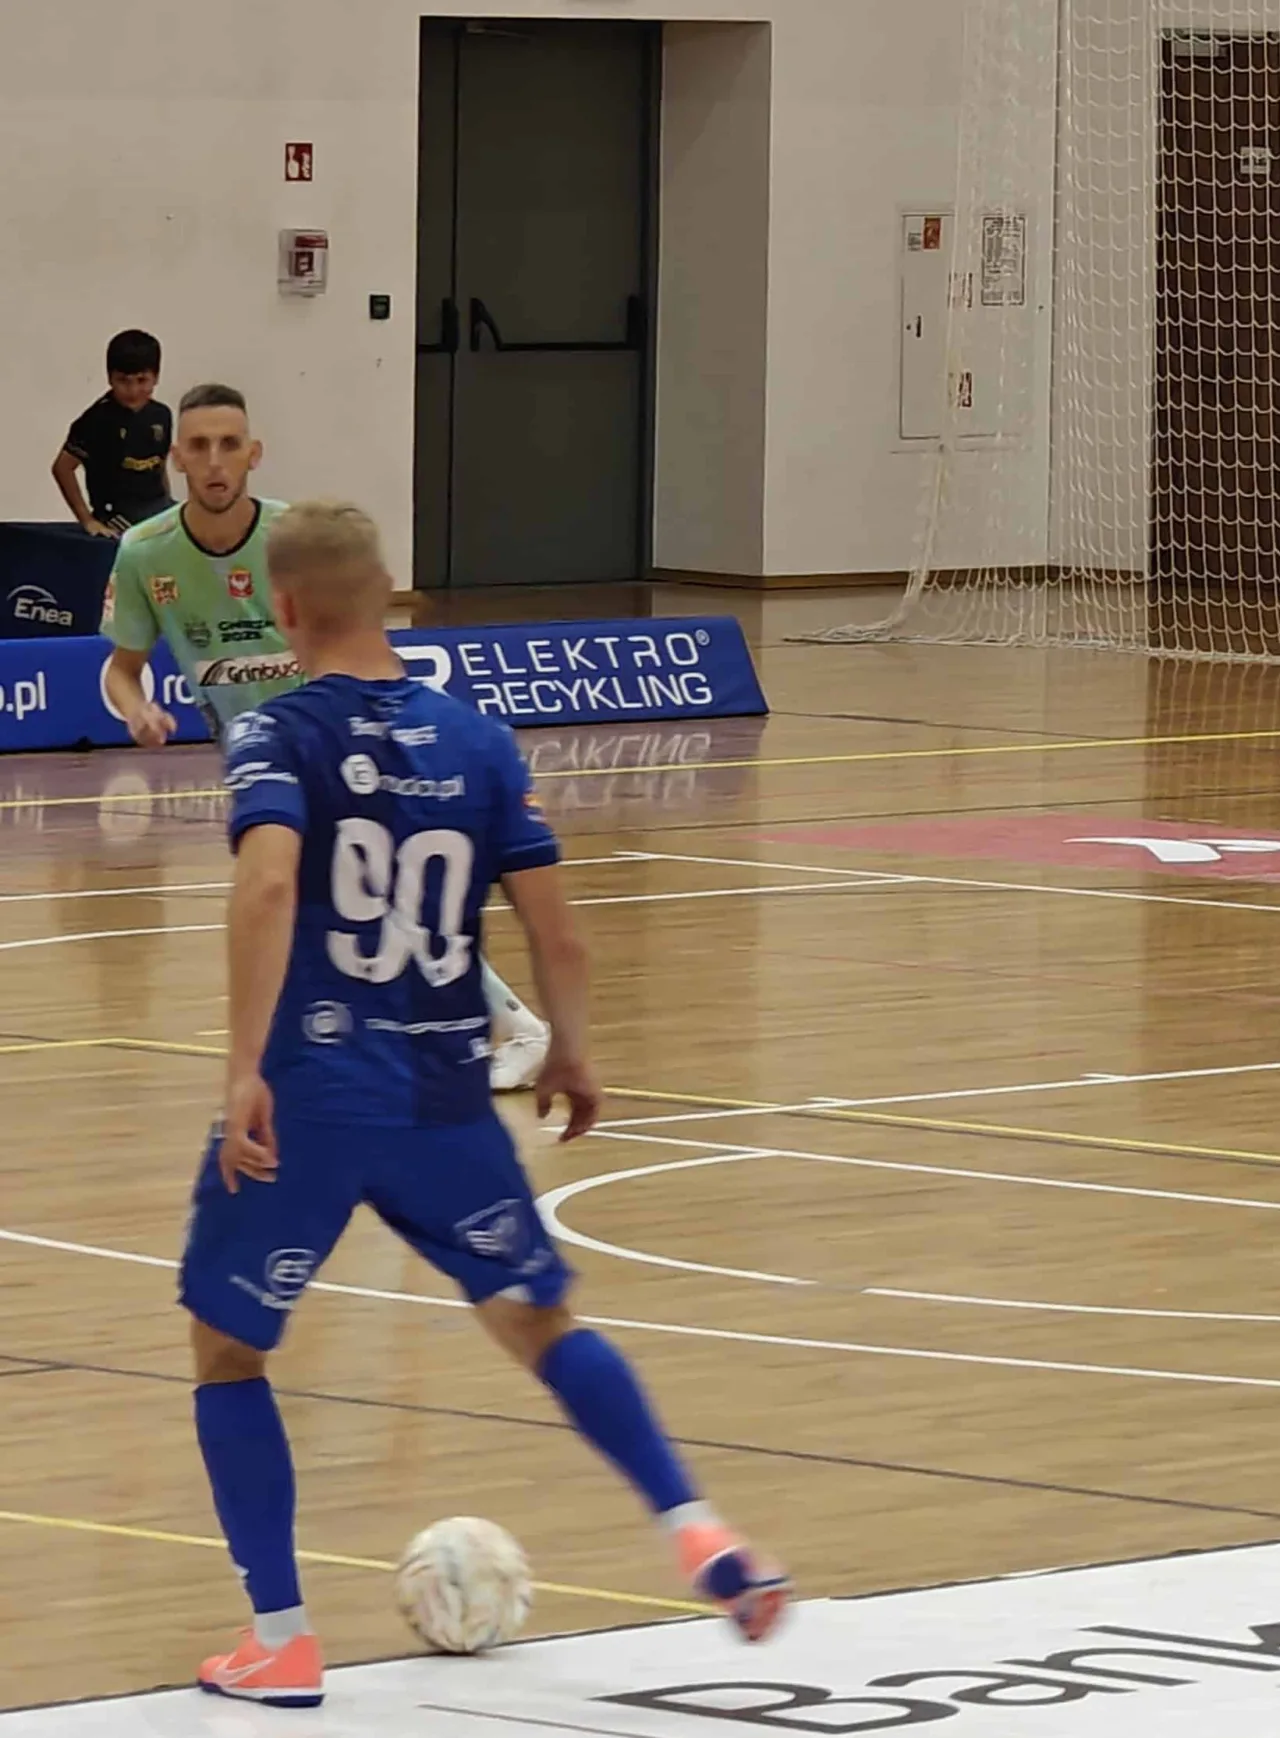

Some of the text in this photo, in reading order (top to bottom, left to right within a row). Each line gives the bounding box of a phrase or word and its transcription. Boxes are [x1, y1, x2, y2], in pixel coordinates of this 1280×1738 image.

[13, 599, 74, 627] Enea
[472, 672, 713, 717] RECYKLING
[327, 818, 475, 988] 90
